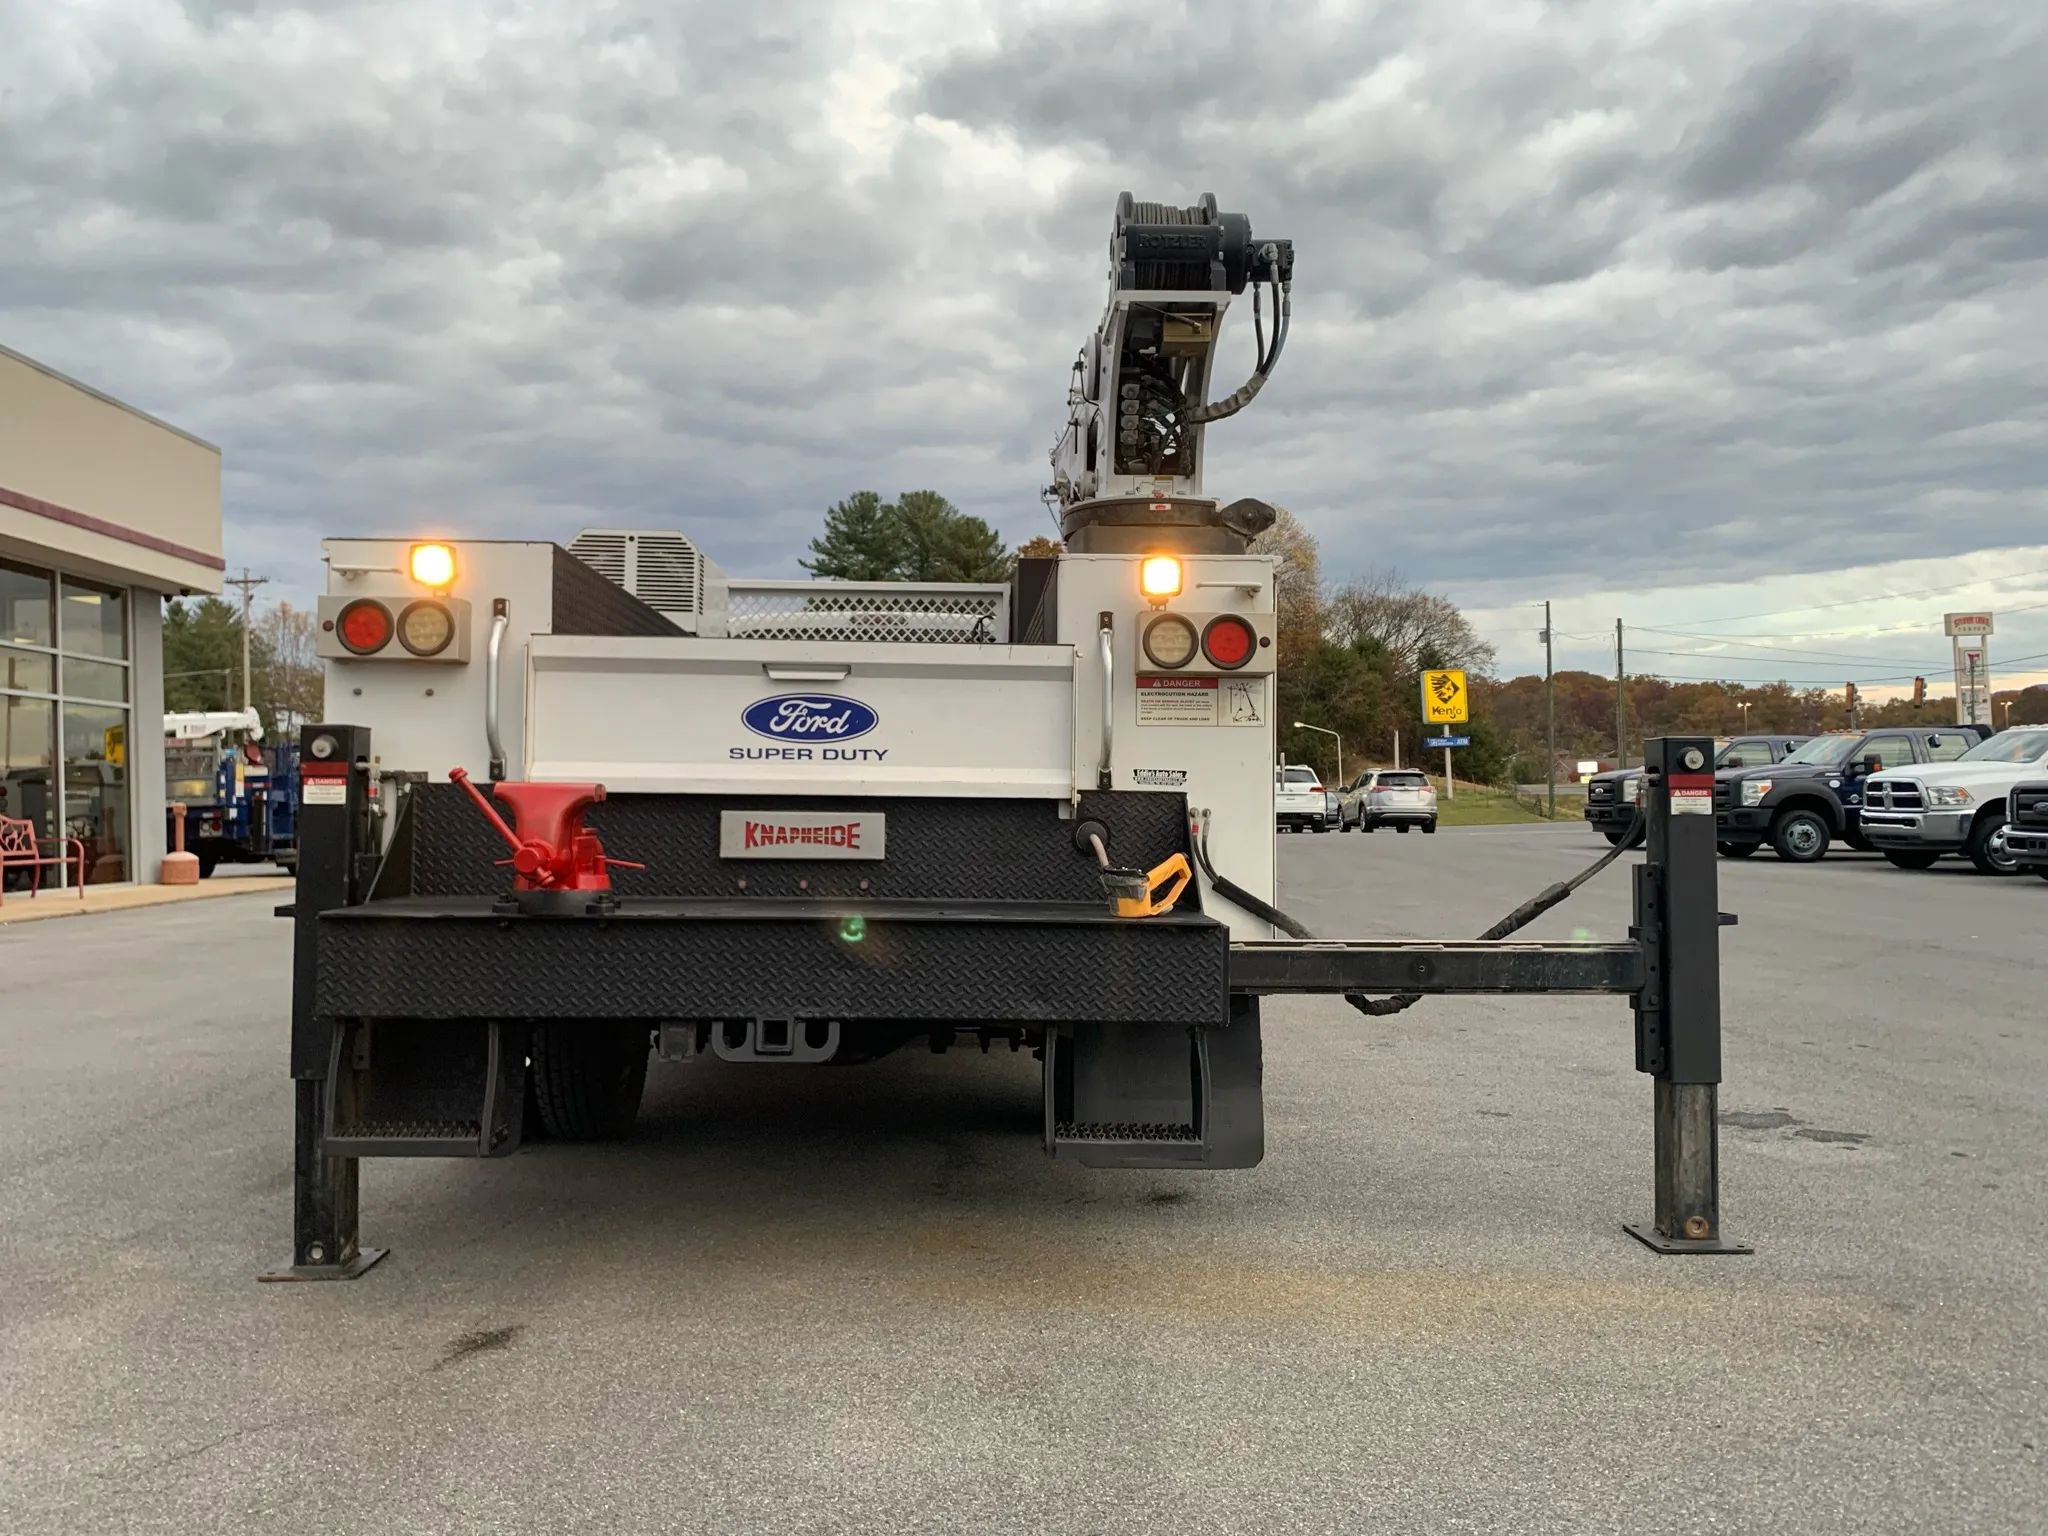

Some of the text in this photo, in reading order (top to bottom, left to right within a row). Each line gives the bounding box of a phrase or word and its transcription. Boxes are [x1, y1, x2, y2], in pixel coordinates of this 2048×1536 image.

[1162, 679, 1201, 688] DANGER
[769, 699, 852, 735] Ford
[1432, 706, 1463, 719] Kenjo
[729, 747, 889, 761] SUPER DUTY
[745, 820, 861, 850] KNAPHEIDE
